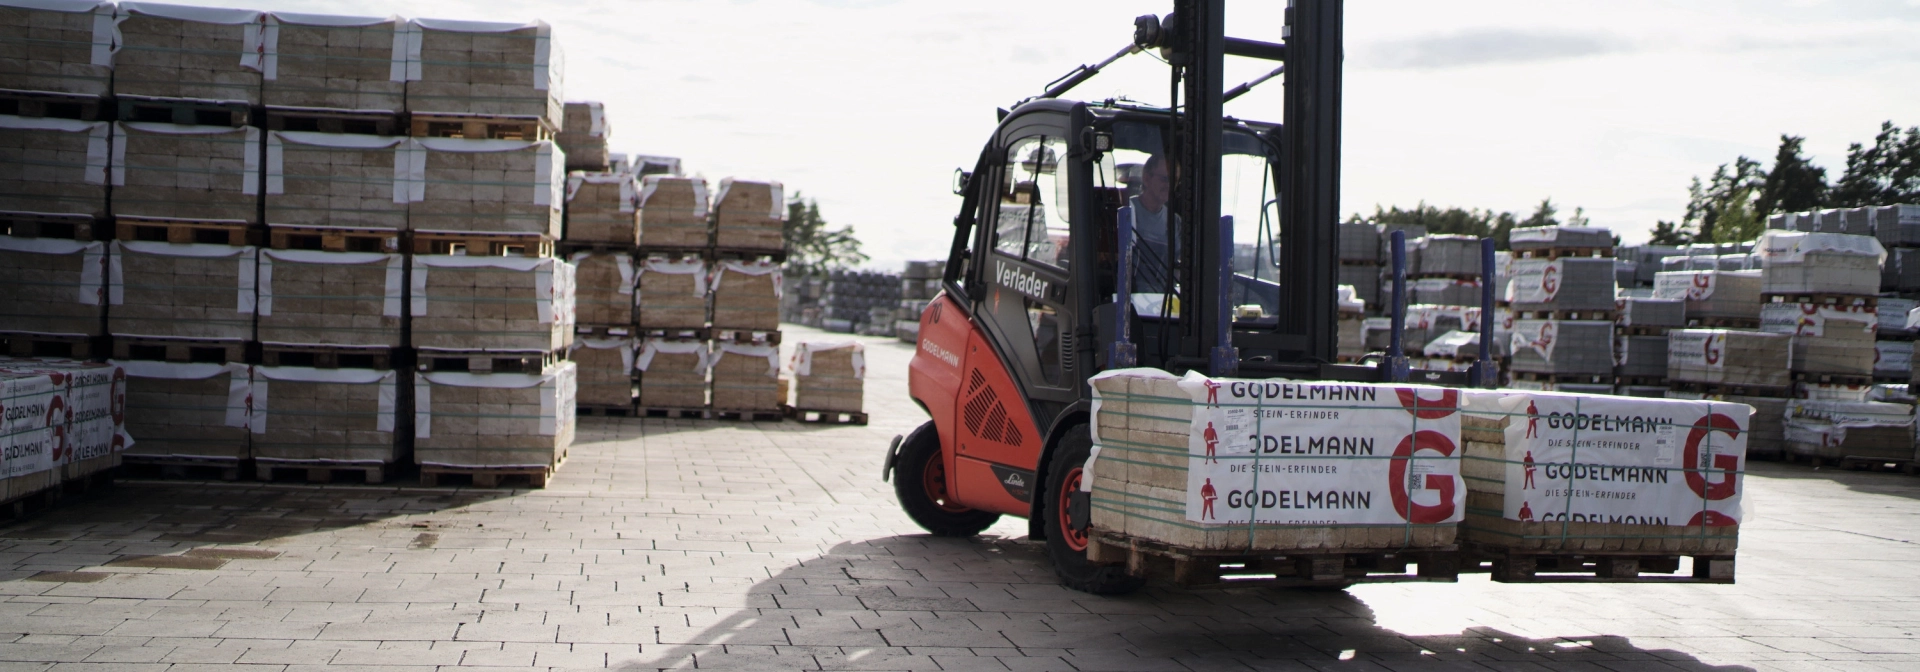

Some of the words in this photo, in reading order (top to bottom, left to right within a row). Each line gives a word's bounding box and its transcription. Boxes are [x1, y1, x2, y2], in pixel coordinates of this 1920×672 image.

[997, 260, 1048, 299] Verlader
[929, 302, 942, 324] 70
[922, 338, 959, 368] GODELMANN
[1230, 382, 1376, 401] GODELMANN
[1253, 409, 1339, 420] STEIN-ERFINDER
[1249, 434, 1374, 455] ODELMANN
[1548, 439, 1563, 447] DIE
[1683, 413, 1741, 500] G
[1230, 464, 1247, 473] DIE
[1251, 464, 1337, 474] STEIN-ERFINDER
[1389, 429, 1456, 524] G
[1545, 462, 1668, 484] GODELMANN
[1004, 472, 1025, 487] Linde
[1227, 489, 1371, 509] GODELMANN
[1545, 489, 1560, 497] DIE
